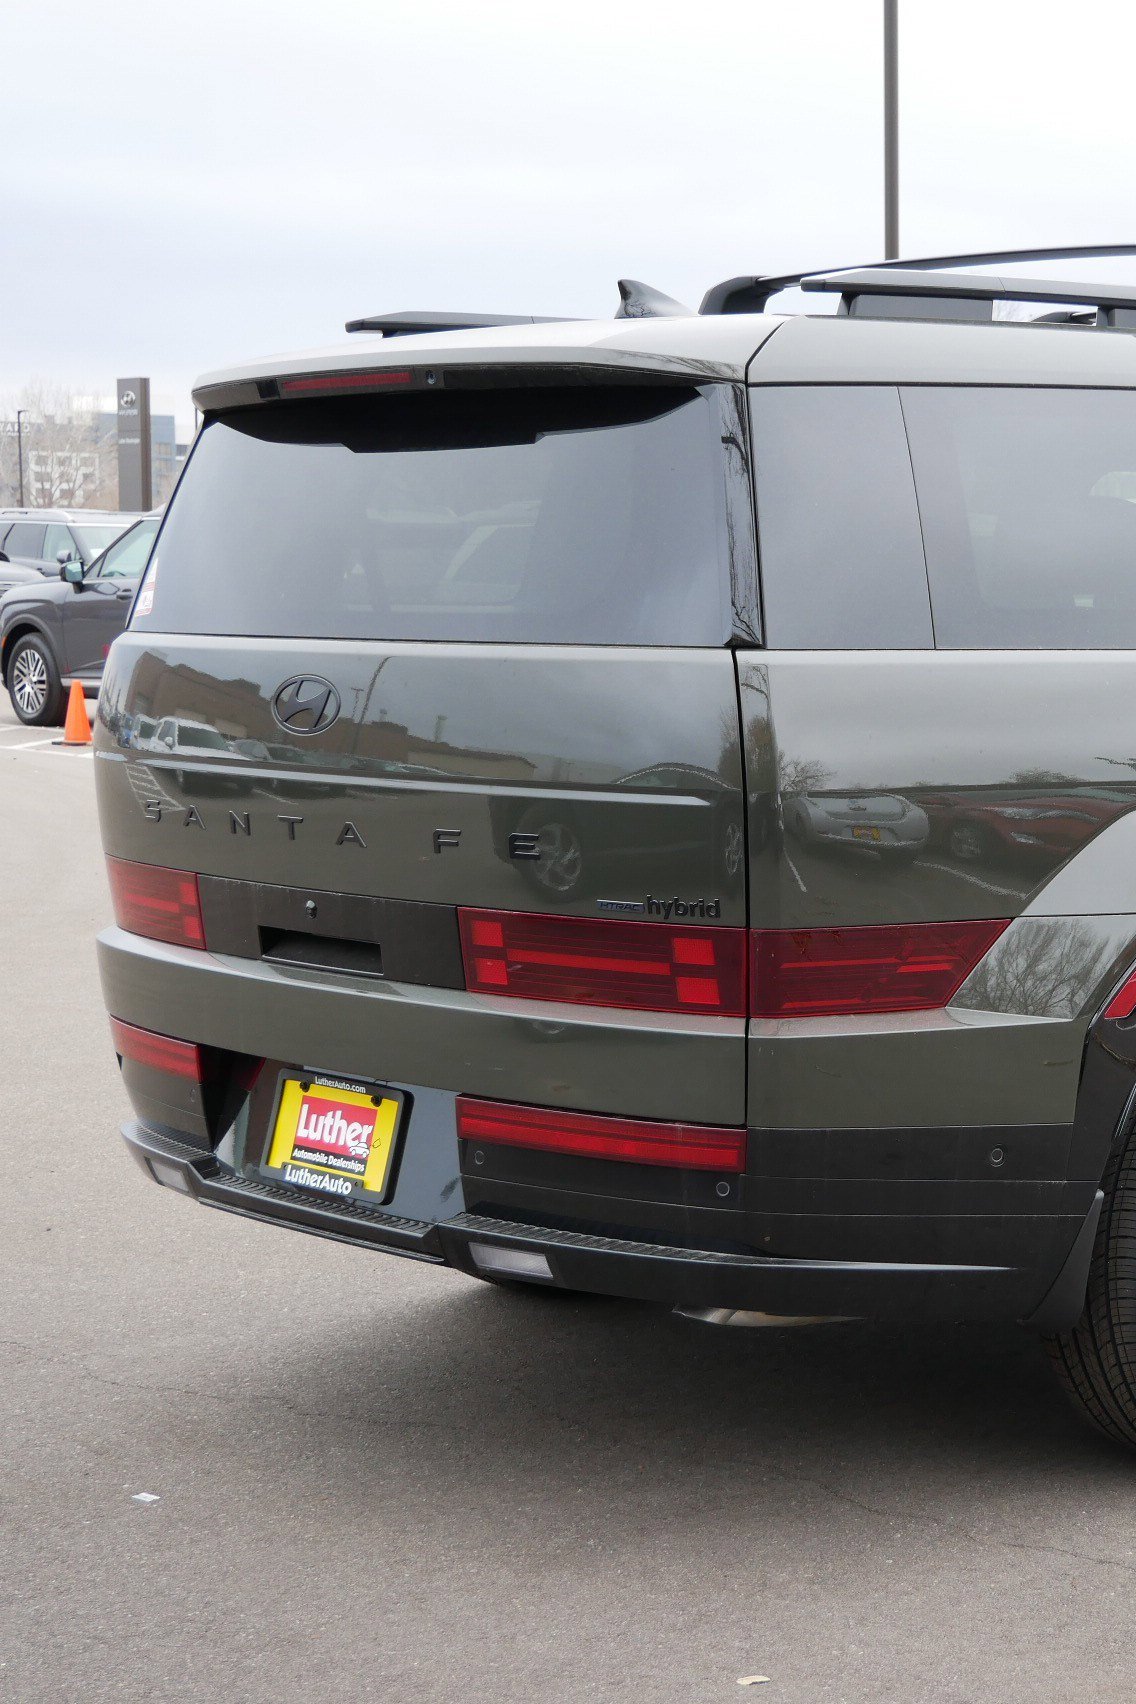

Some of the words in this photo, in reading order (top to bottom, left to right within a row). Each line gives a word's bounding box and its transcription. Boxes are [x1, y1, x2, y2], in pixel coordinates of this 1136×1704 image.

[145, 799, 367, 848] SANTA
[433, 828, 541, 860] FE
[646, 894, 720, 919] hybrid
[315, 1076, 366, 1094] LutherAuto.com
[297, 1103, 374, 1147] Luther
[292, 1148, 328, 1164] Automobile
[328, 1154, 365, 1172] Dealerships
[285, 1163, 352, 1195] LutherAuto
